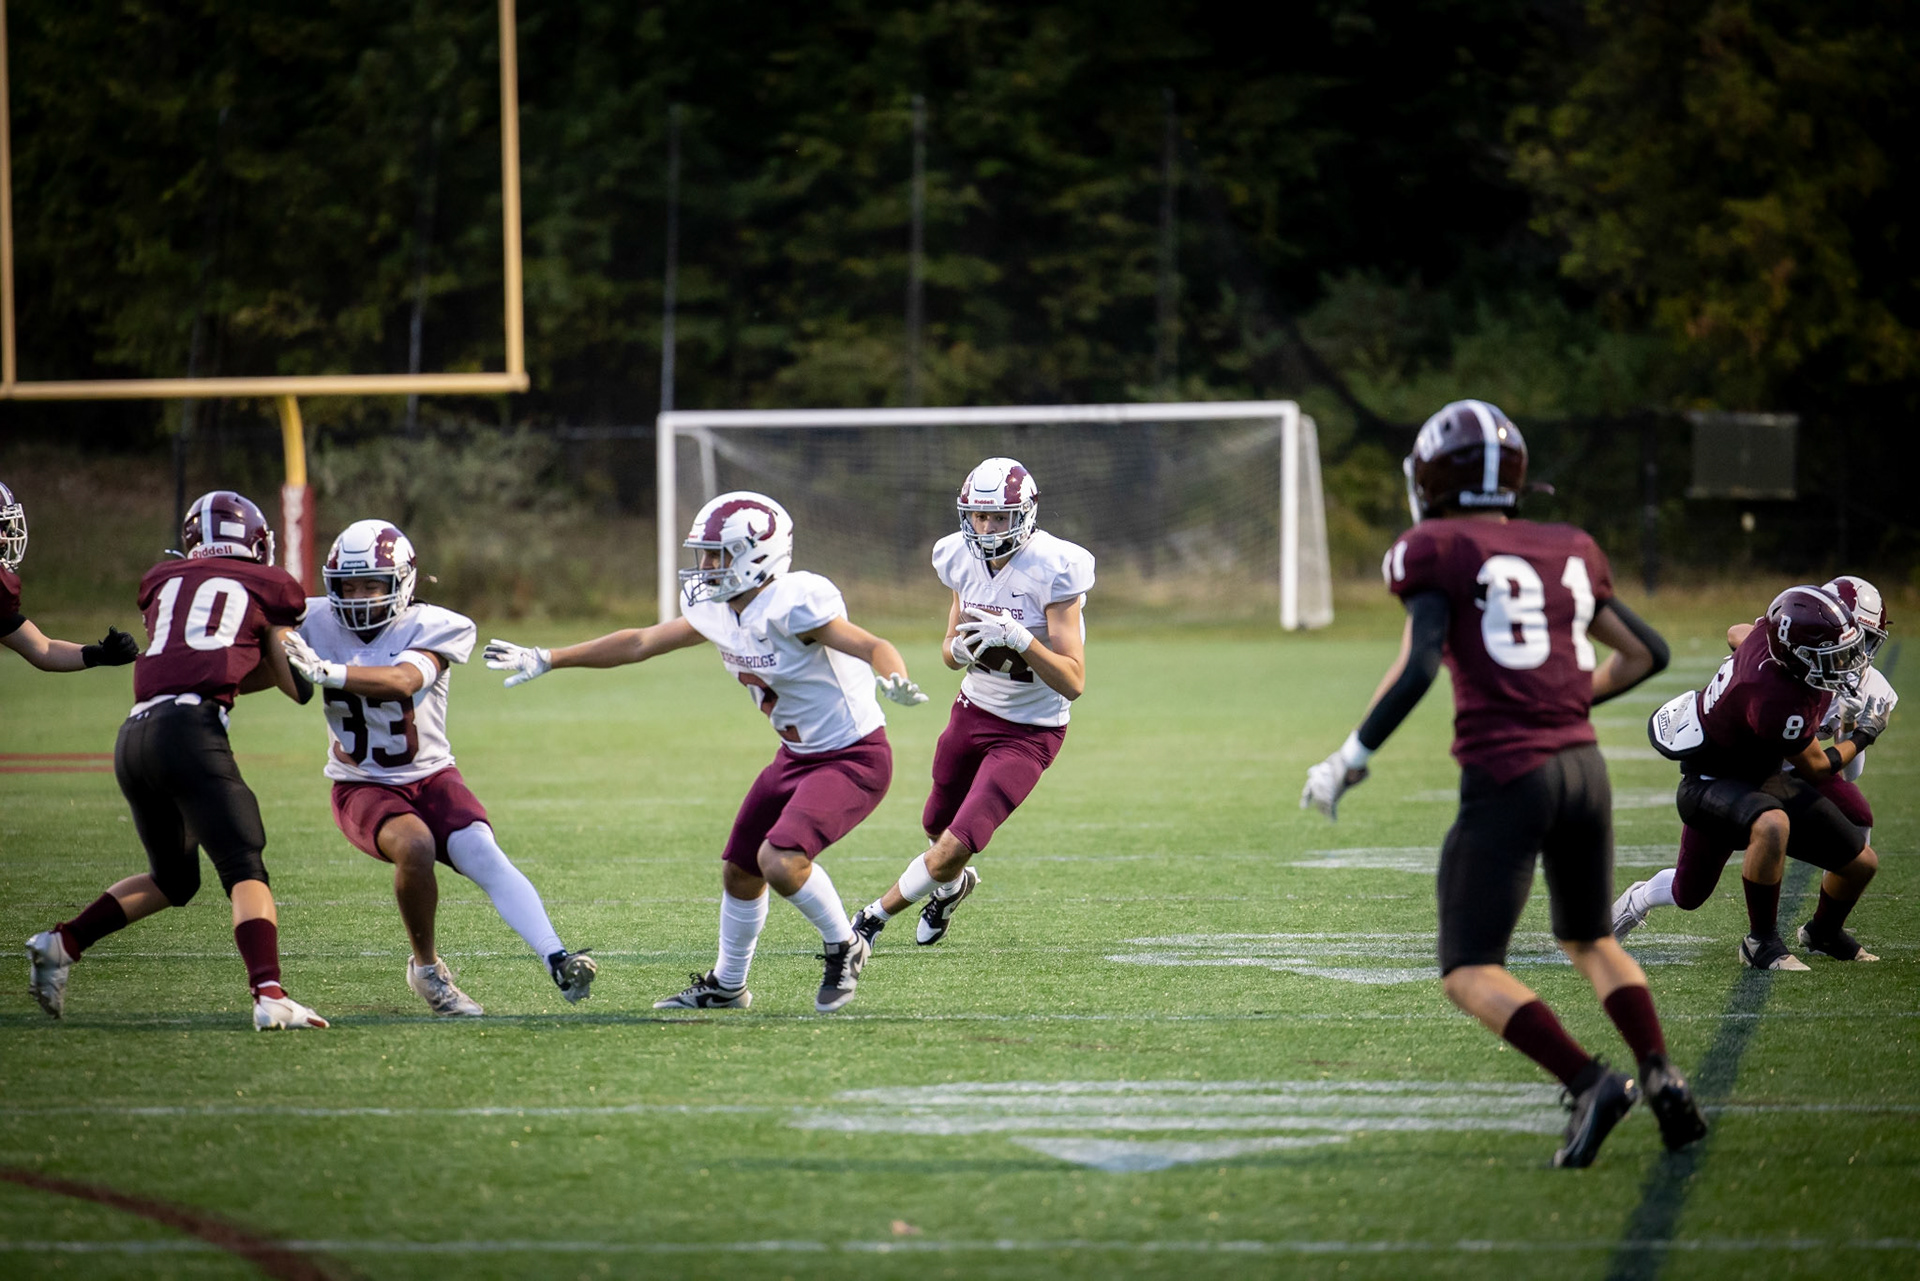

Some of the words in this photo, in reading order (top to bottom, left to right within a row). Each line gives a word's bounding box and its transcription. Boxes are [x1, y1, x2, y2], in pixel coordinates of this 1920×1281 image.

[145, 576, 249, 656] 10
[1473, 554, 1597, 671] 81
[1777, 613, 1793, 641] 8
[322, 687, 419, 768] 33
[737, 671, 801, 743] 2
[1782, 714, 1805, 740] 8
